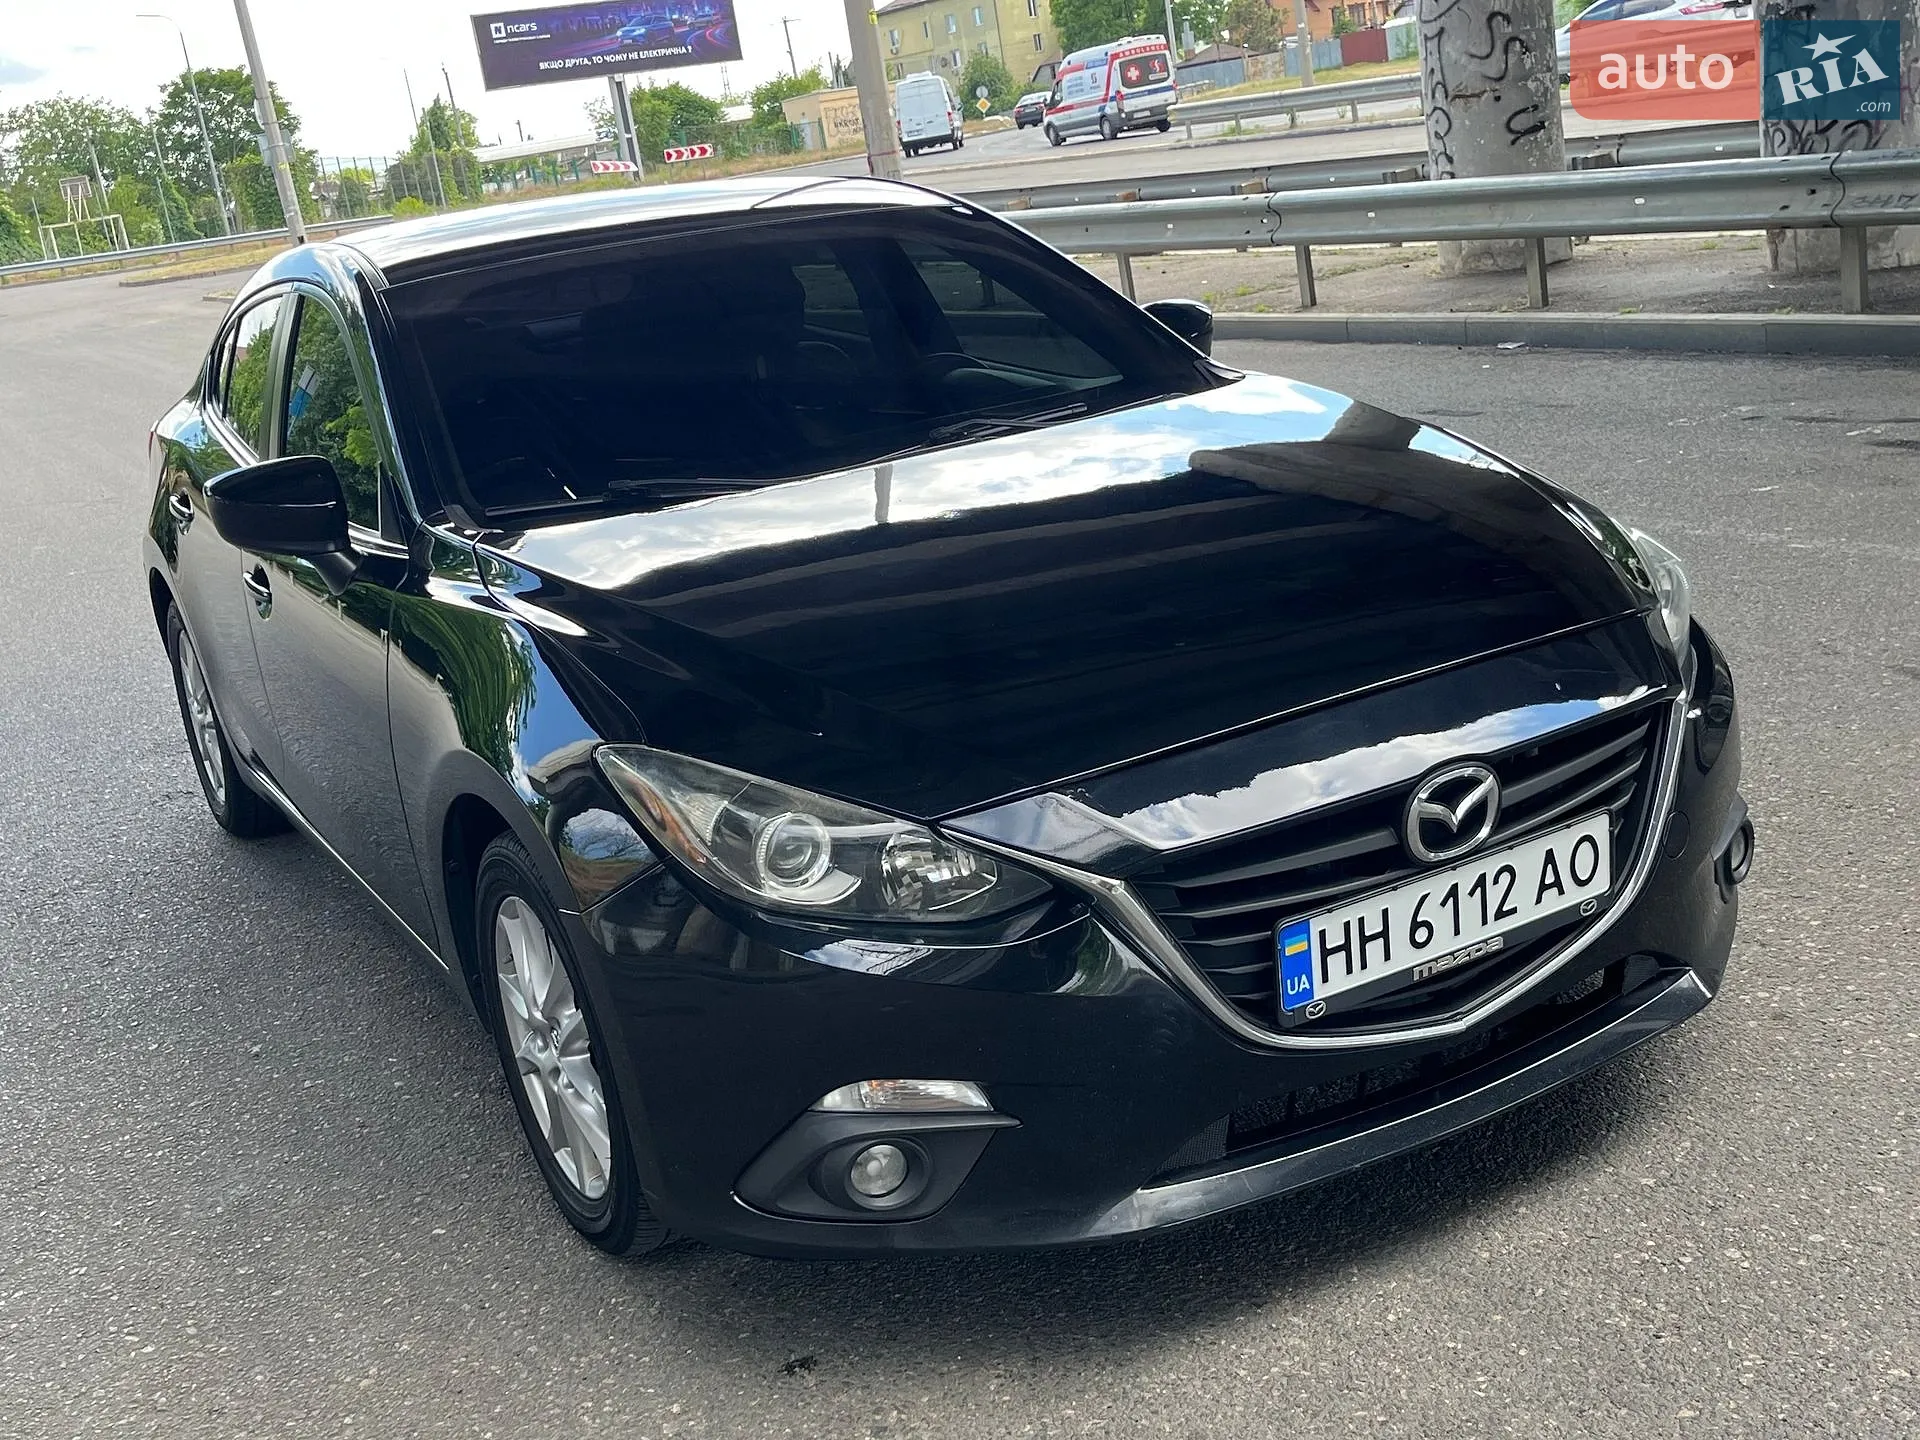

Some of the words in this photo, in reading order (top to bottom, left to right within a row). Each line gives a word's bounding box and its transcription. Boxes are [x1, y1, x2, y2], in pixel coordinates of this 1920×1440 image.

[507, 22, 538, 33] ncars
[539, 59, 564, 70] ЯКЩО
[565, 57, 591, 68] ДРУГА,
[592, 55, 603, 64] ТО
[604, 52, 627, 63] ЧОМУ
[628, 51, 639, 60] НЕ
[639, 46, 687, 59] ЕЛЕКТРИЧНА
[1119, 44, 1165, 57] AMBULANCE
[1318, 907, 1391, 983] HH
[1409, 864, 1518, 950] 6112
[1535, 834, 1600, 906] AO
[1412, 935, 1504, 982] mazda
[1287, 973, 1311, 996] UA
